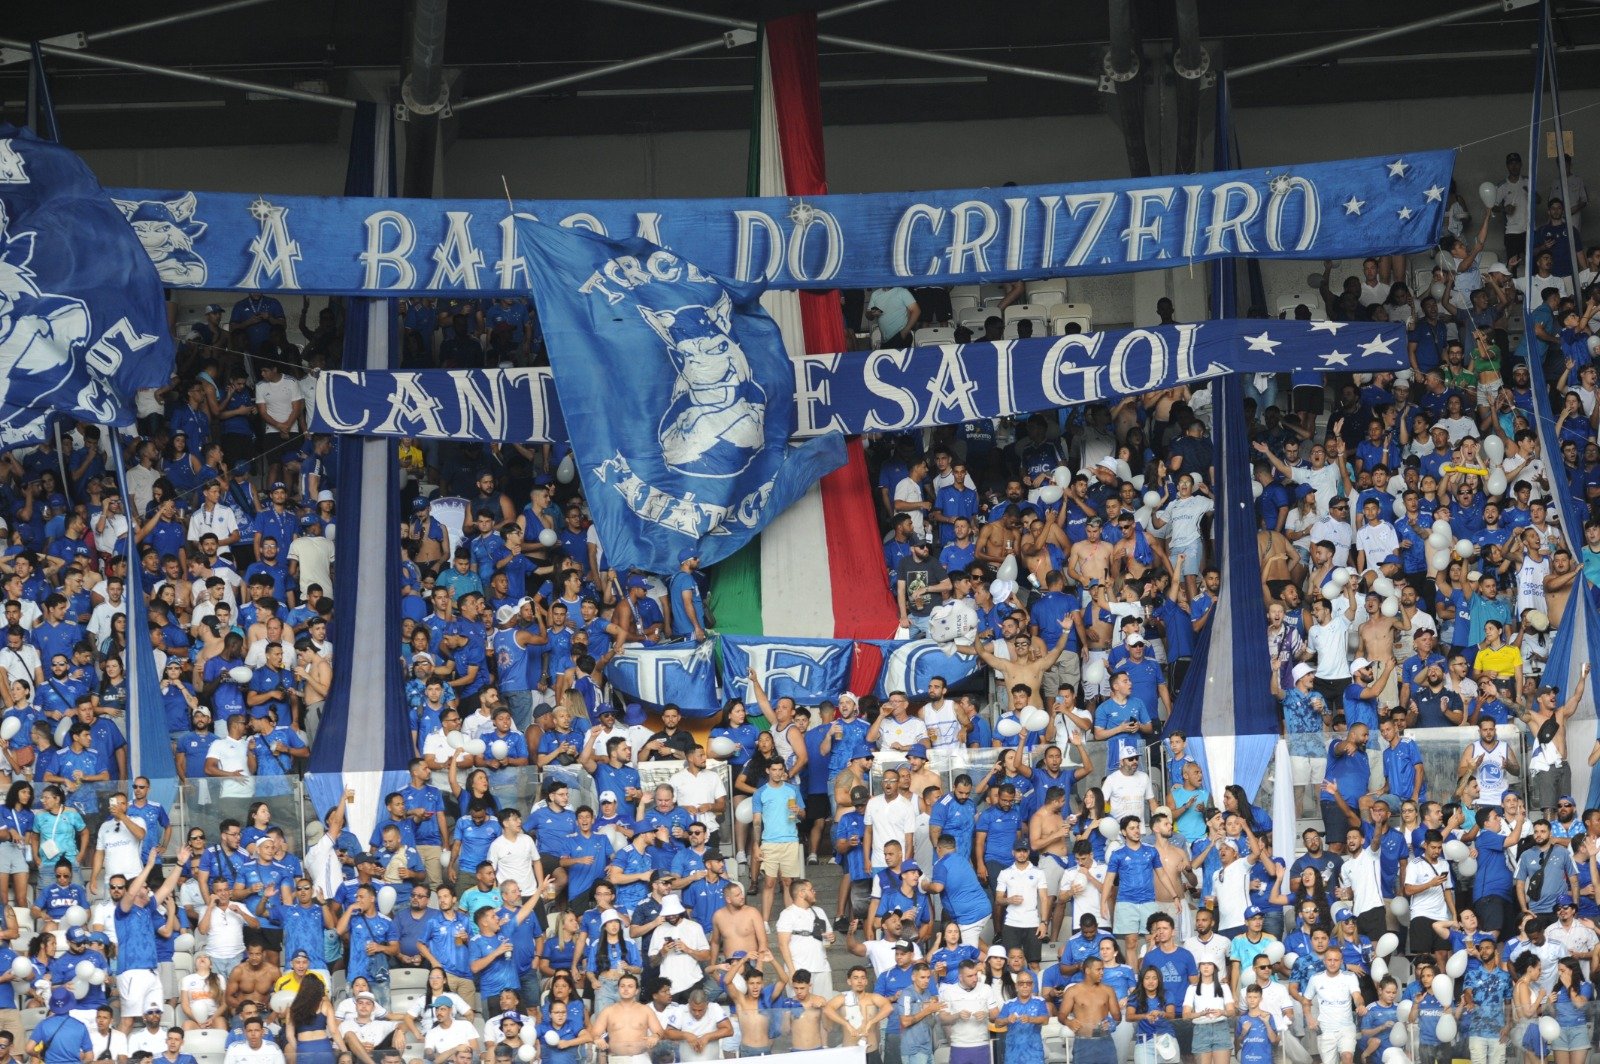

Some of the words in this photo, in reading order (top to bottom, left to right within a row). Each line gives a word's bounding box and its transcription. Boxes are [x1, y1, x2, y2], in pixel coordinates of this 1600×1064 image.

[235, 206, 302, 289] A
[360, 211, 672, 290] BAR
[732, 208, 844, 282] DO
[893, 176, 1321, 277] CRUZEIRO
[315, 367, 569, 443] CANT
[863, 340, 1031, 432] SAI
[1042, 324, 1233, 406] GOL
[1489, 766, 1499, 775] 30
[51, 898, 78, 907] CAIXA
